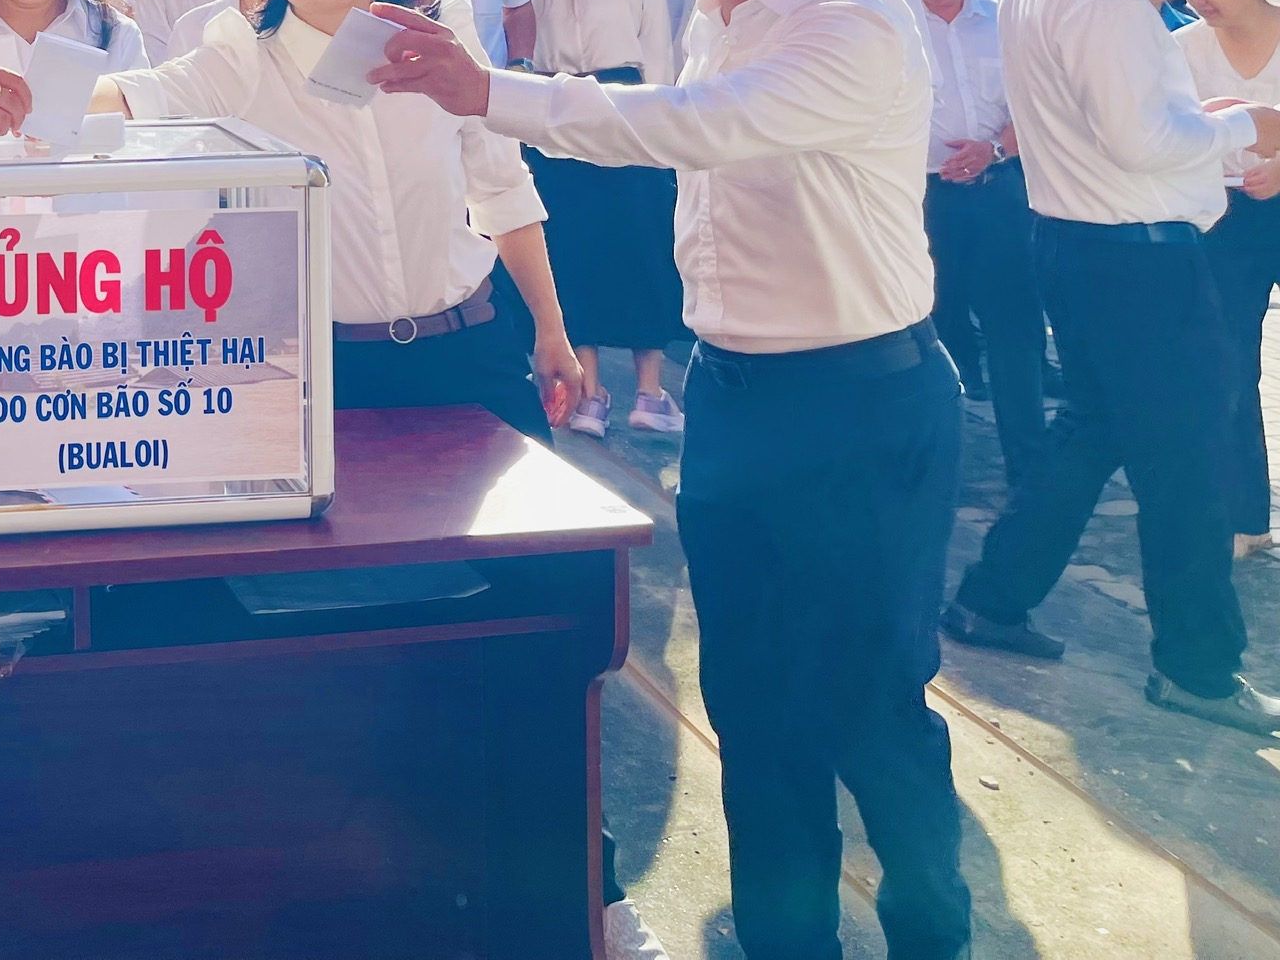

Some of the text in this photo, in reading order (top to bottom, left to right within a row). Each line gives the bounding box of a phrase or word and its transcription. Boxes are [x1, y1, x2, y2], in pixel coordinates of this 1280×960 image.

[145, 230, 233, 322] HỘ
[40, 335, 93, 371] BÀO
[102, 340, 128, 375] BỊ
[136, 331, 212, 371] THIỆT
[222, 337, 265, 370] HẠI
[35, 389, 86, 422] CƠN
[97, 385, 149, 419] BÃO
[158, 379, 191, 416] SỐ
[203, 387, 233, 414] 10
[58, 439, 169, 473] (BUALOI)
